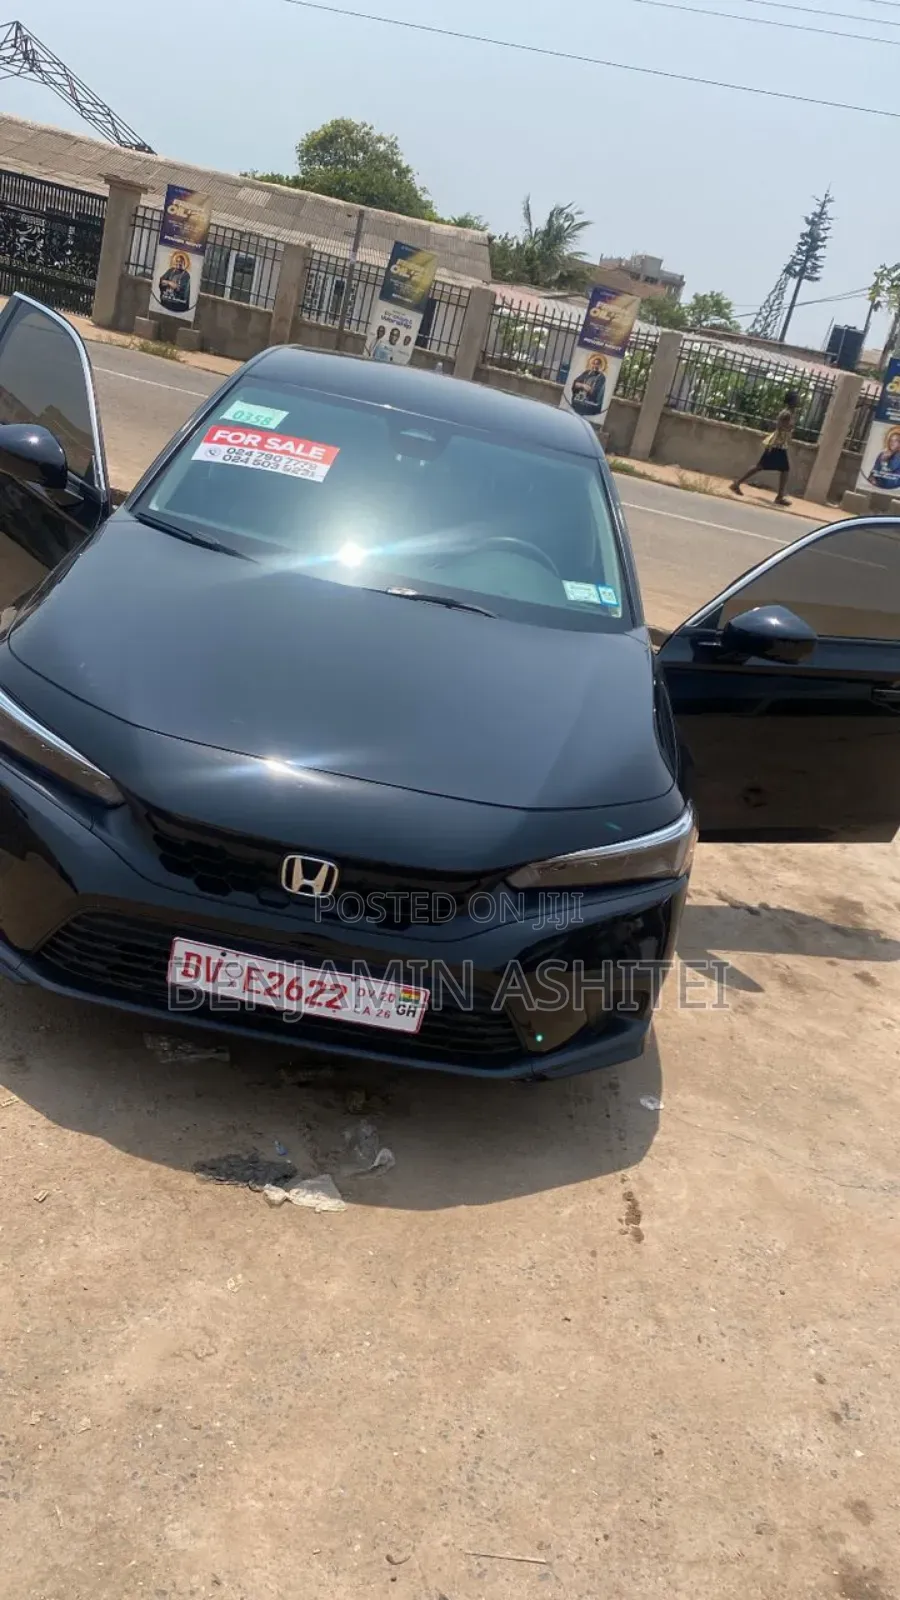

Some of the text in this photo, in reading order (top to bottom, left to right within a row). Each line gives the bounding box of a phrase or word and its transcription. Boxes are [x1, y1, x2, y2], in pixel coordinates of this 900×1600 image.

[212, 429, 326, 460] FOR SALE
[222, 454, 249, 465] 024
[227, 447, 255, 458] 024
[243, 967, 348, 1011] E2622
[396, 1004, 417, 1018] GH
